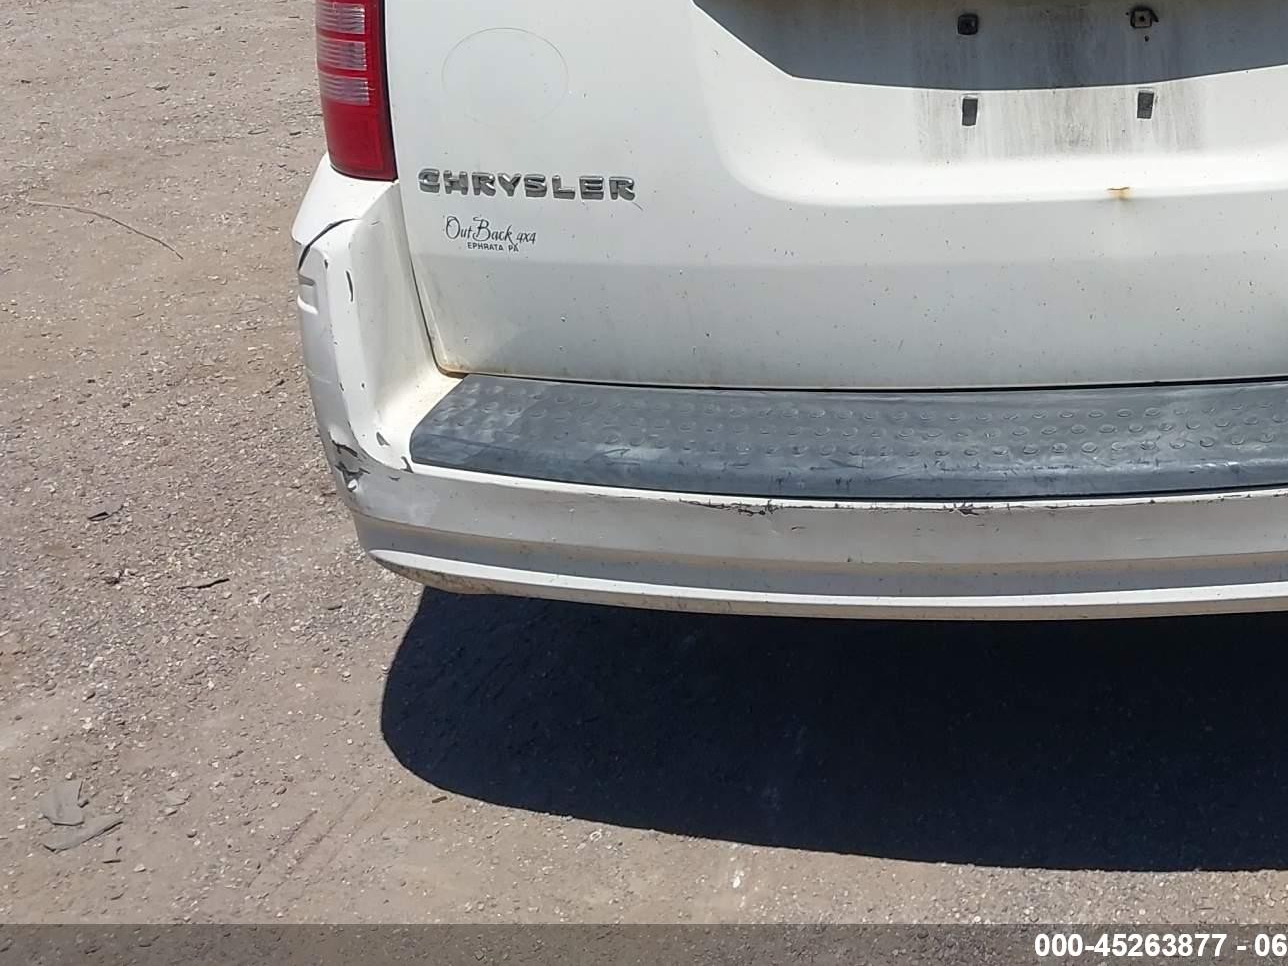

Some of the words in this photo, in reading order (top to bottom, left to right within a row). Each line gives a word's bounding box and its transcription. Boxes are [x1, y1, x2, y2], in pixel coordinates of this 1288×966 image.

[418, 168, 636, 201] CHRYSLER
[467, 242, 504, 251] EPHRATA
[508, 244, 519, 252] PA
